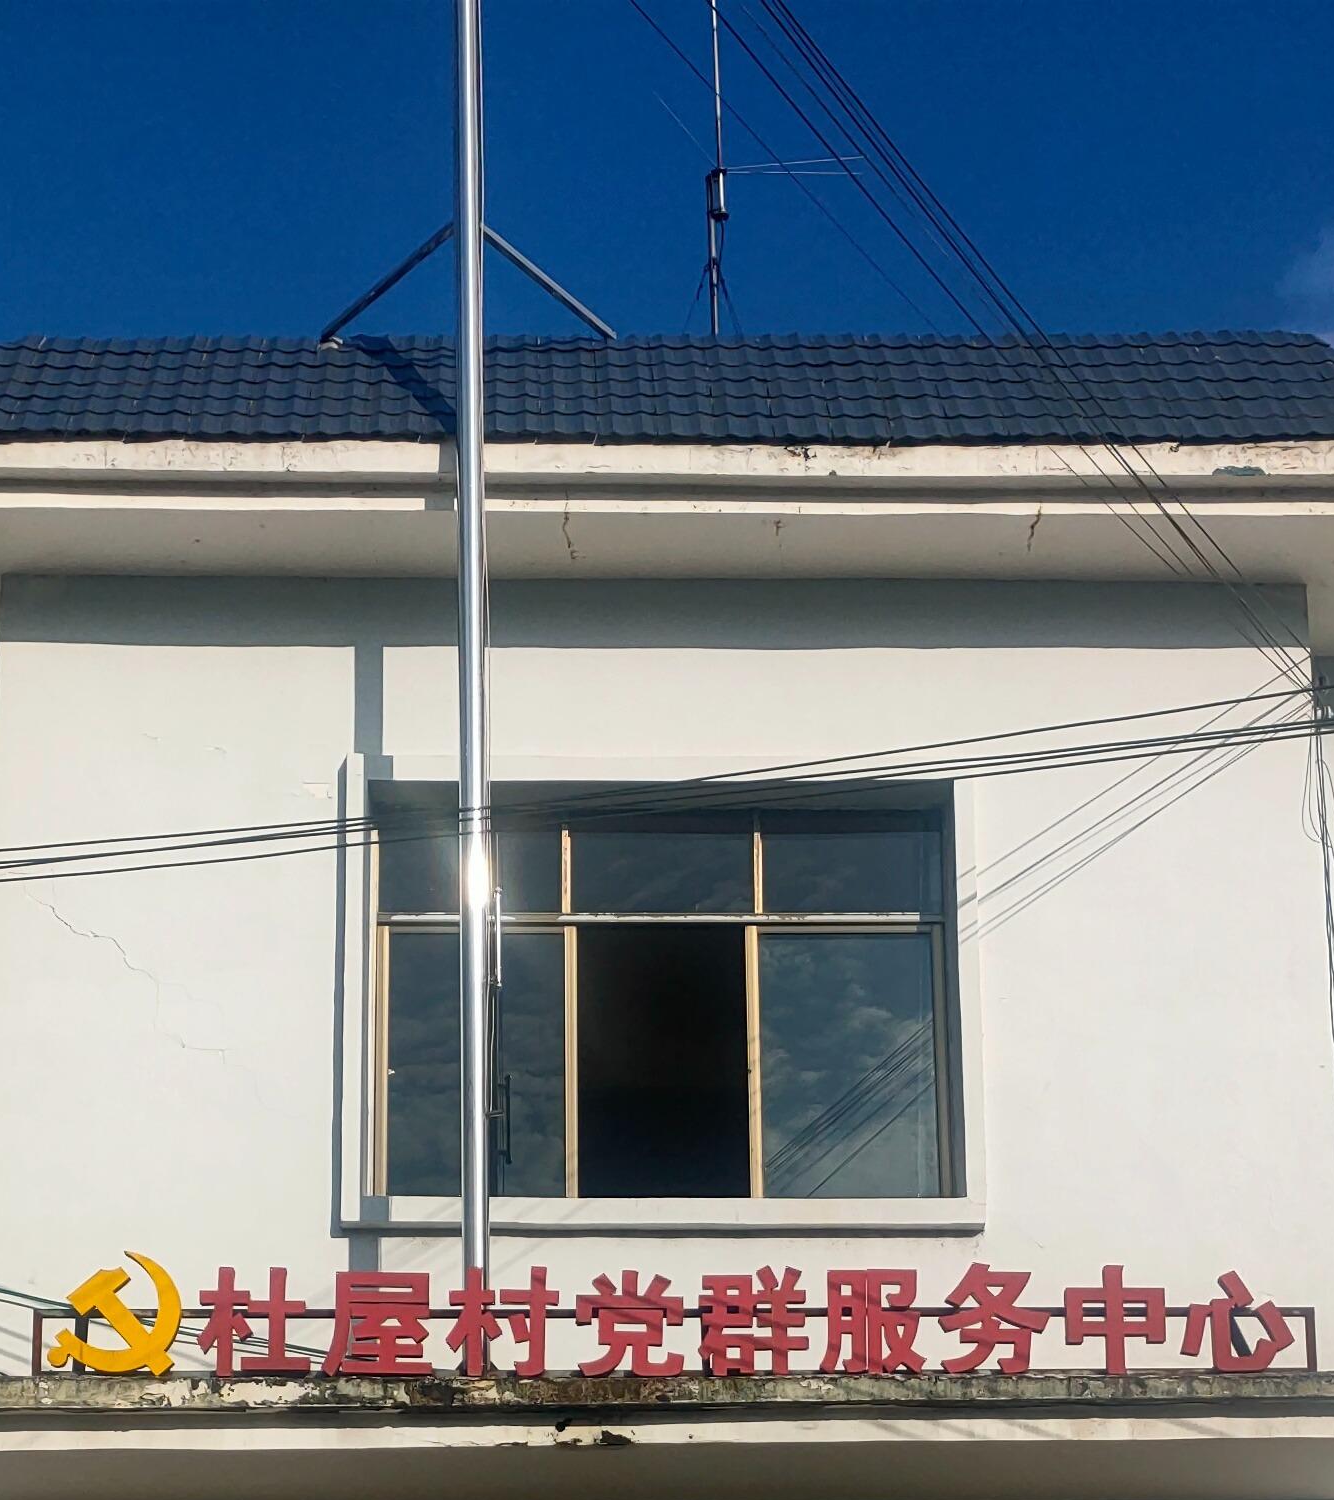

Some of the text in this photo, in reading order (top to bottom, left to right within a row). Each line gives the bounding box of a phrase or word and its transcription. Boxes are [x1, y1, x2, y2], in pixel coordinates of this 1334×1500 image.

[197, 1263, 1295, 1378] 杜屋村党群服务中心
